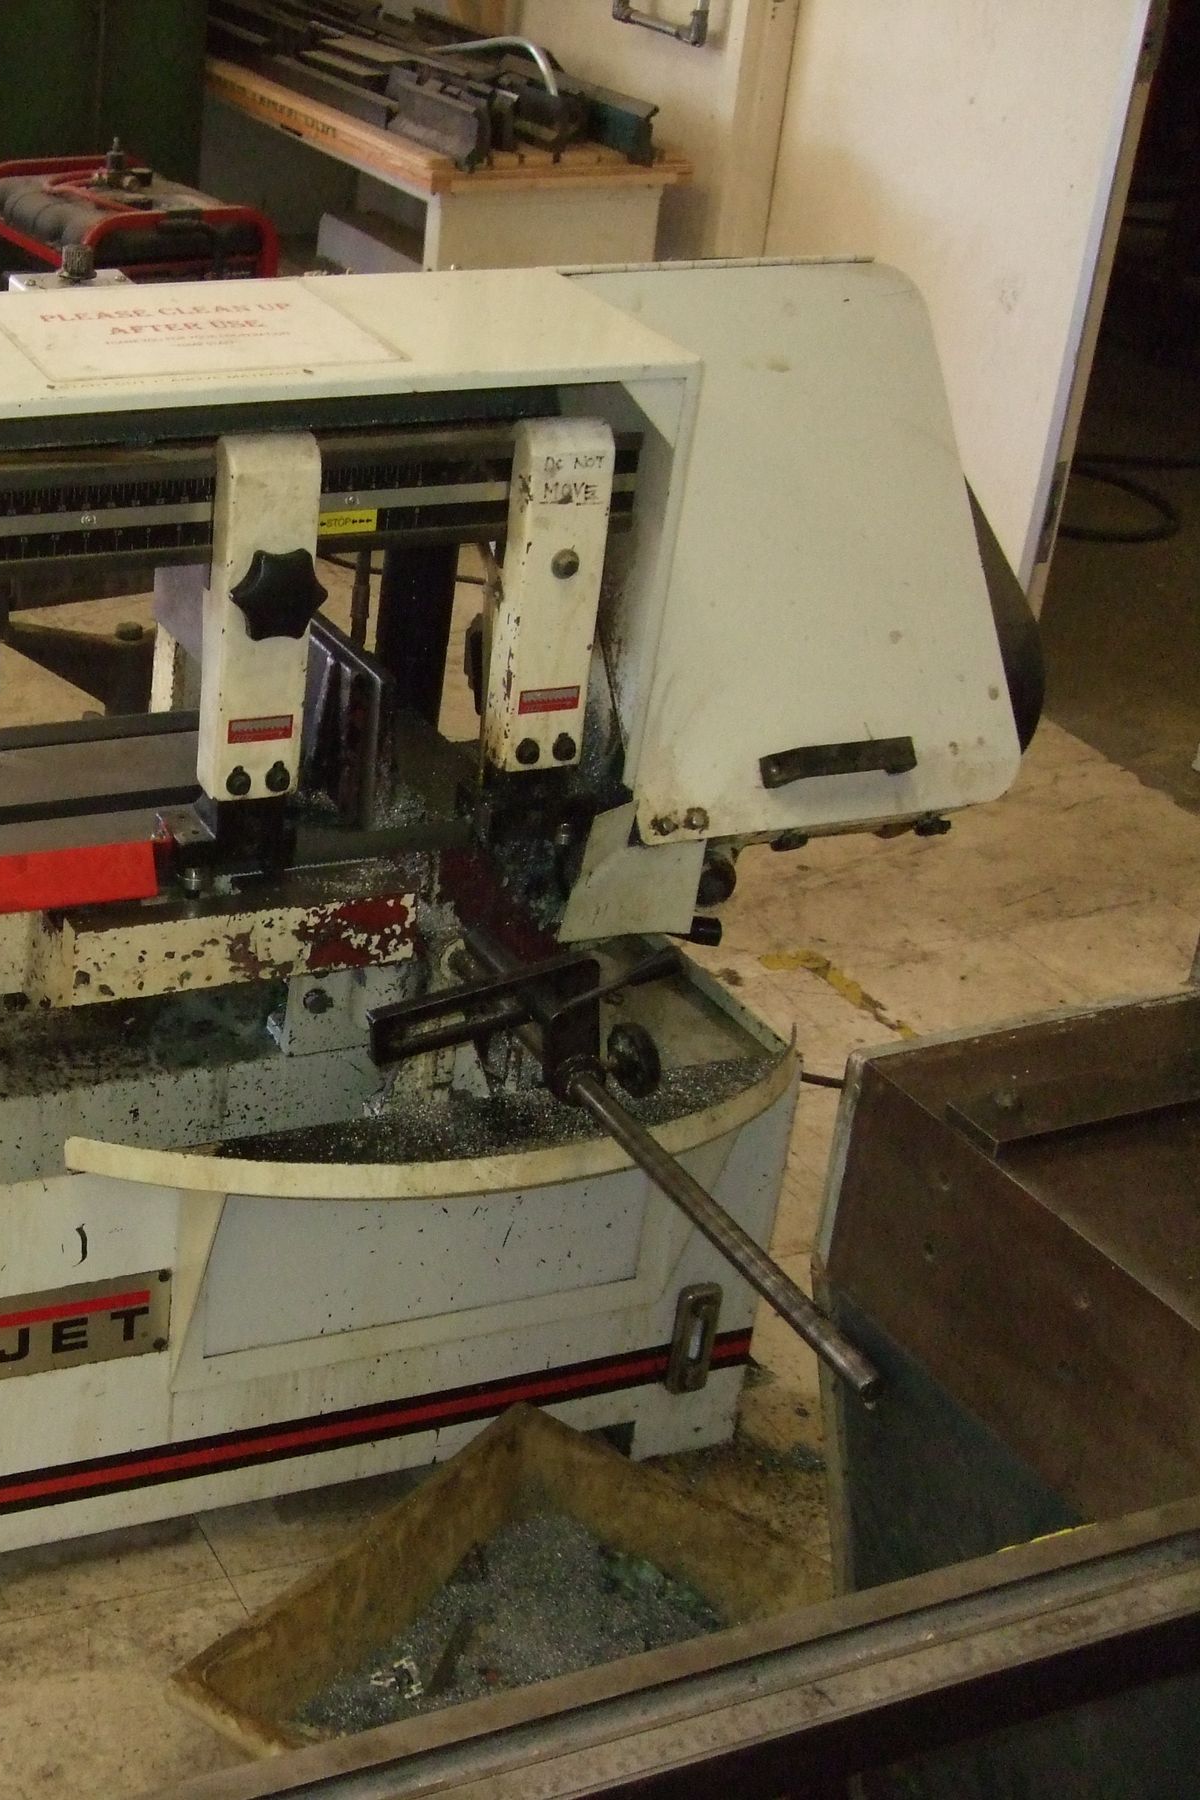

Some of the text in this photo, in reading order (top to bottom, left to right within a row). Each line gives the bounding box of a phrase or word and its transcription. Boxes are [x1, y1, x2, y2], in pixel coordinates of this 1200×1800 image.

[39, 302, 291, 323] PLEASE CLEAN UP
[110, 319, 264, 336] AFTER USE
[574, 455, 605, 470] NOT
[543, 481, 598, 502] MOVE
[326, 517, 351, 528] STOP
